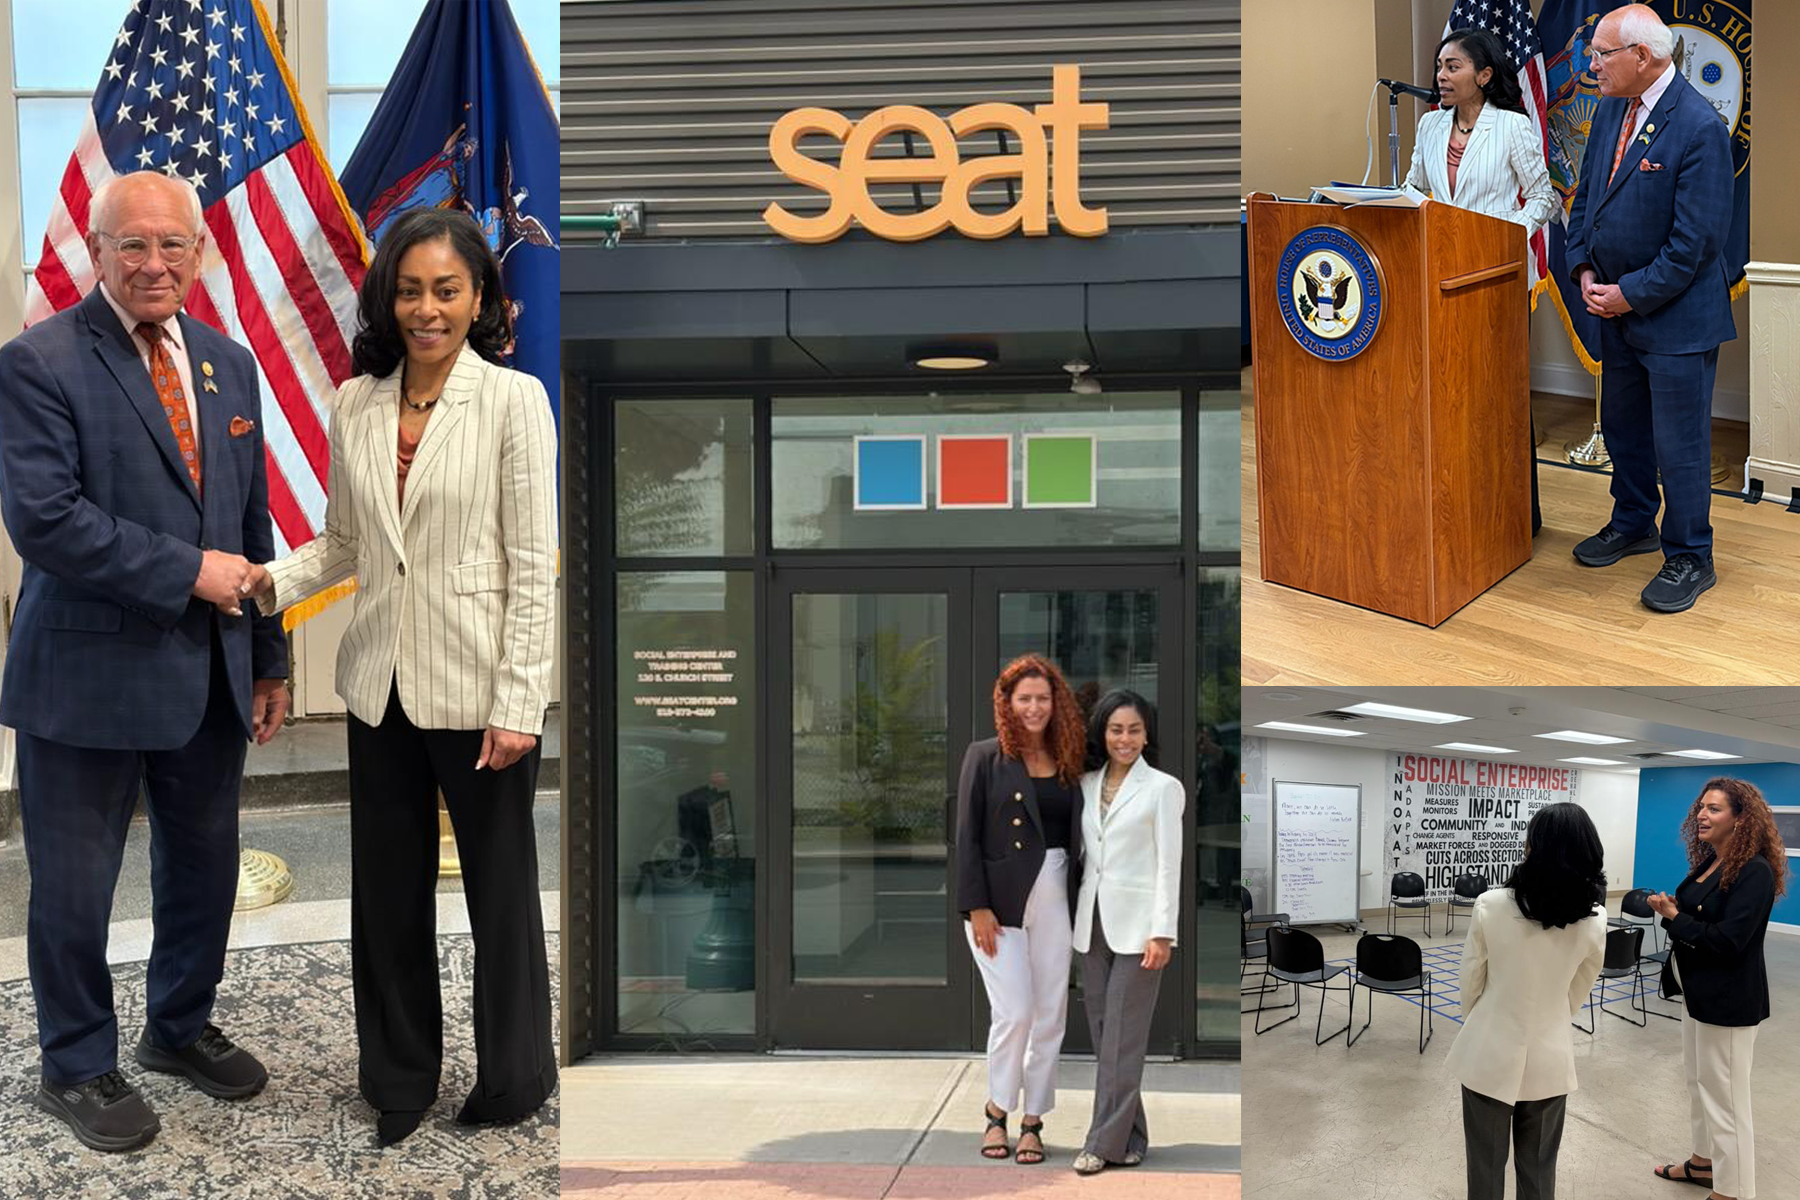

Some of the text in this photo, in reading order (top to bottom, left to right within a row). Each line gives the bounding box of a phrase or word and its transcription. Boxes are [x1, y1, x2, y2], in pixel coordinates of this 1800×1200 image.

[1673, 0, 1716, 28] U.S.
[1736, 111, 1751, 149] OF
[762, 63, 1109, 243] seat
[1280, 232, 1378, 297] HOUSE OF REPRESENTATIVES
[1280, 294, 1378, 357] UNITED STATES OF AMERICA
[688, 662, 723, 670] CENTER
[702, 673, 734, 682] STREET
[1404, 755, 1569, 791] SOCIAL ENTERPRISE
[1427, 783, 1552, 801] MISSION MEETS MARKETPLACE
[1425, 798, 1459, 806] MEASURES
[1469, 798, 1520, 819] IMPACT
[1423, 807, 1458, 815] MONITORS
[1421, 819, 1487, 831] COMMUNITY
[1472, 832, 1519, 840] RESPONSIVE
[1416, 842, 1447, 850] MARKET
[1490, 841, 1517, 849] DOGGED
[1426, 851, 1451, 865] CUTS
[1453, 850, 1490, 864] ACROSS
[1425, 866, 1462, 889] HIGH
